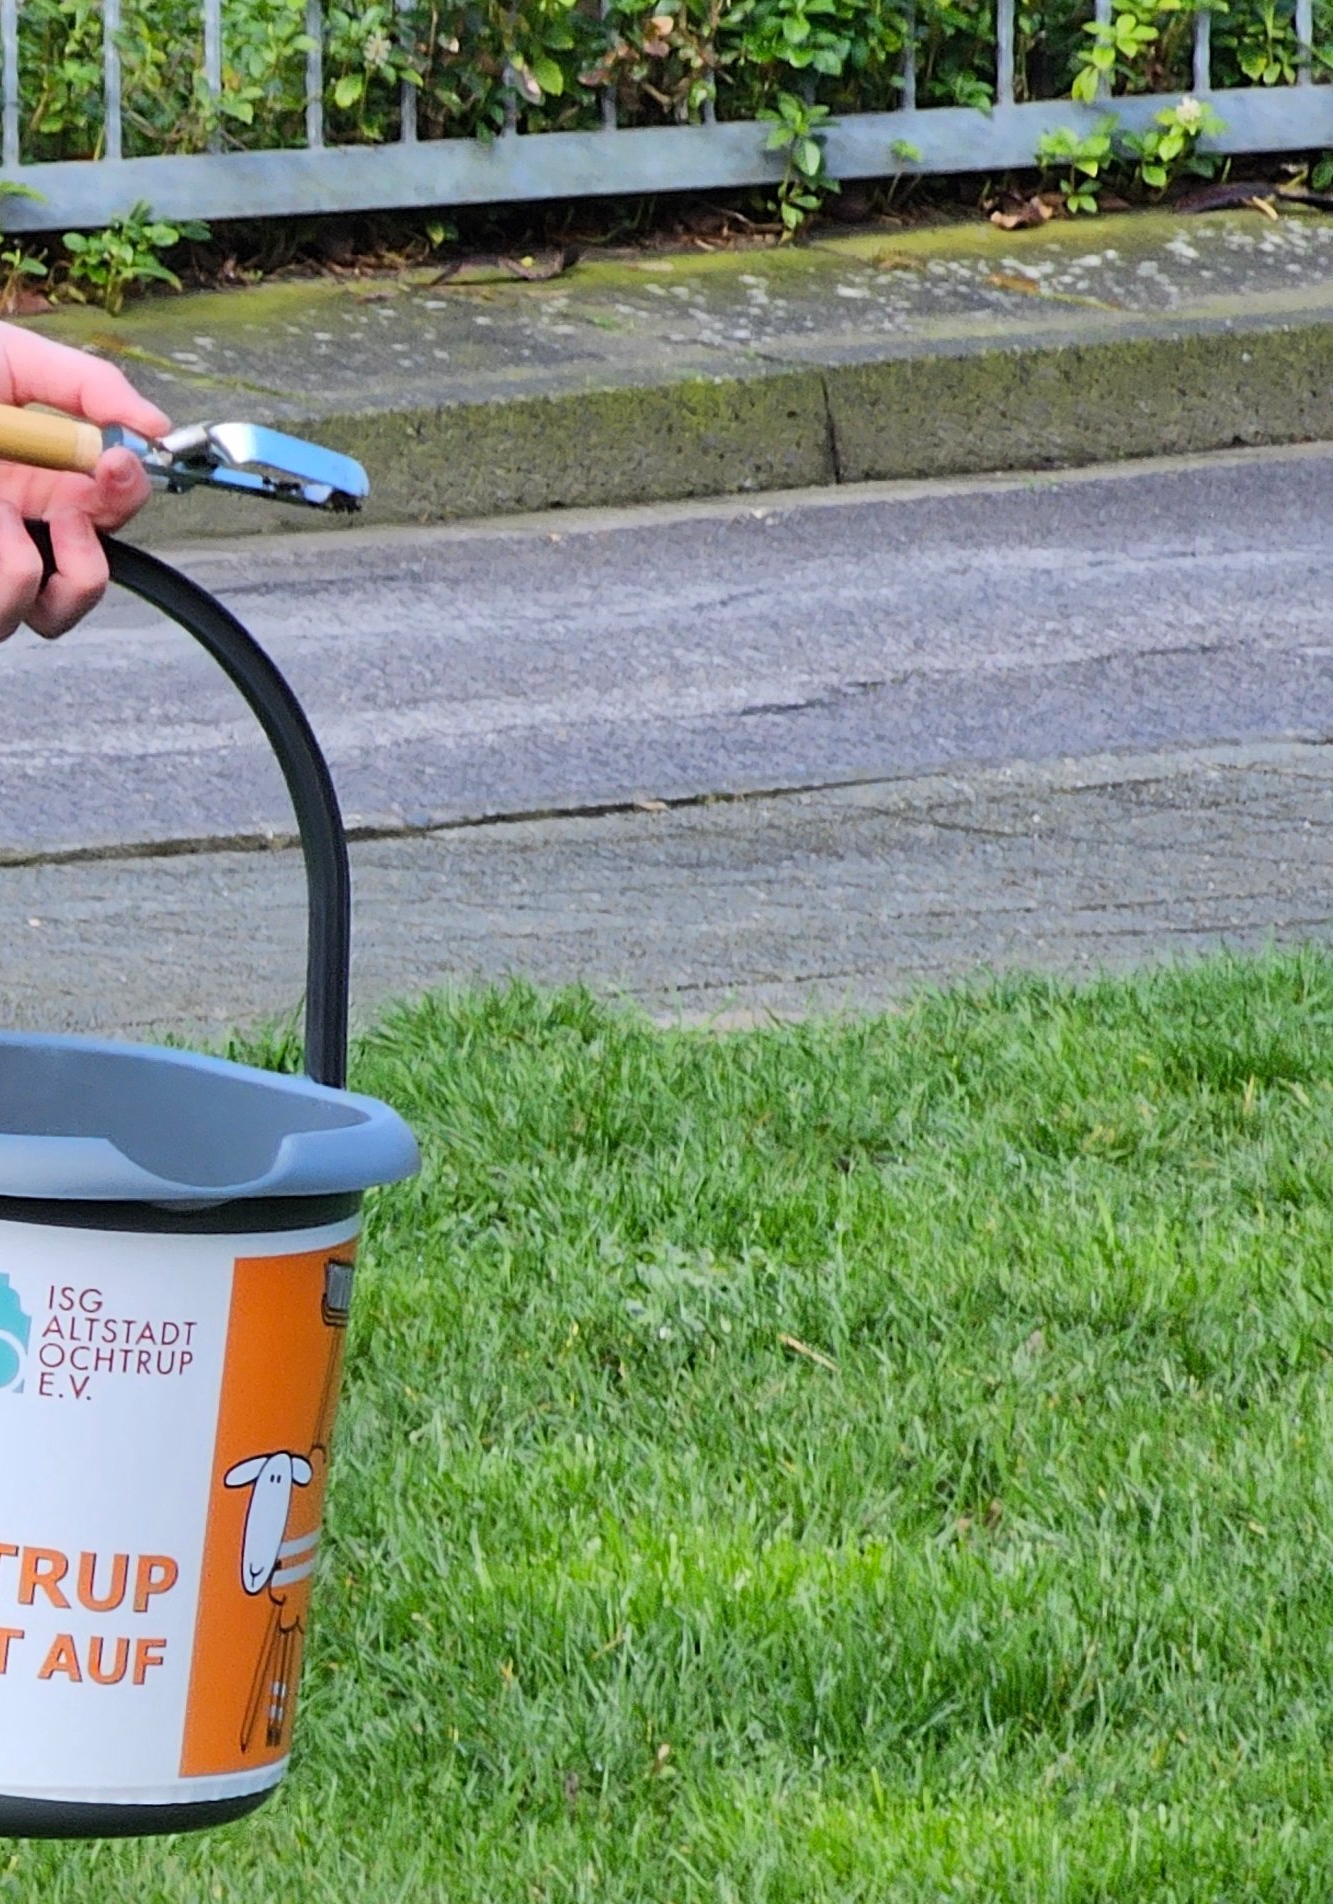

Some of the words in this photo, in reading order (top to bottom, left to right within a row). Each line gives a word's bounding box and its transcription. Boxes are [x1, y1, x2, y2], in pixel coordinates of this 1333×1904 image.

[48, 1285, 103, 1313] ISG
[41, 1314, 198, 1347] ALTSTADT
[38, 1342, 194, 1376] OCHTRUP
[38, 1371, 92, 1401] E.V.
[36, 1633, 168, 1686] AUF
